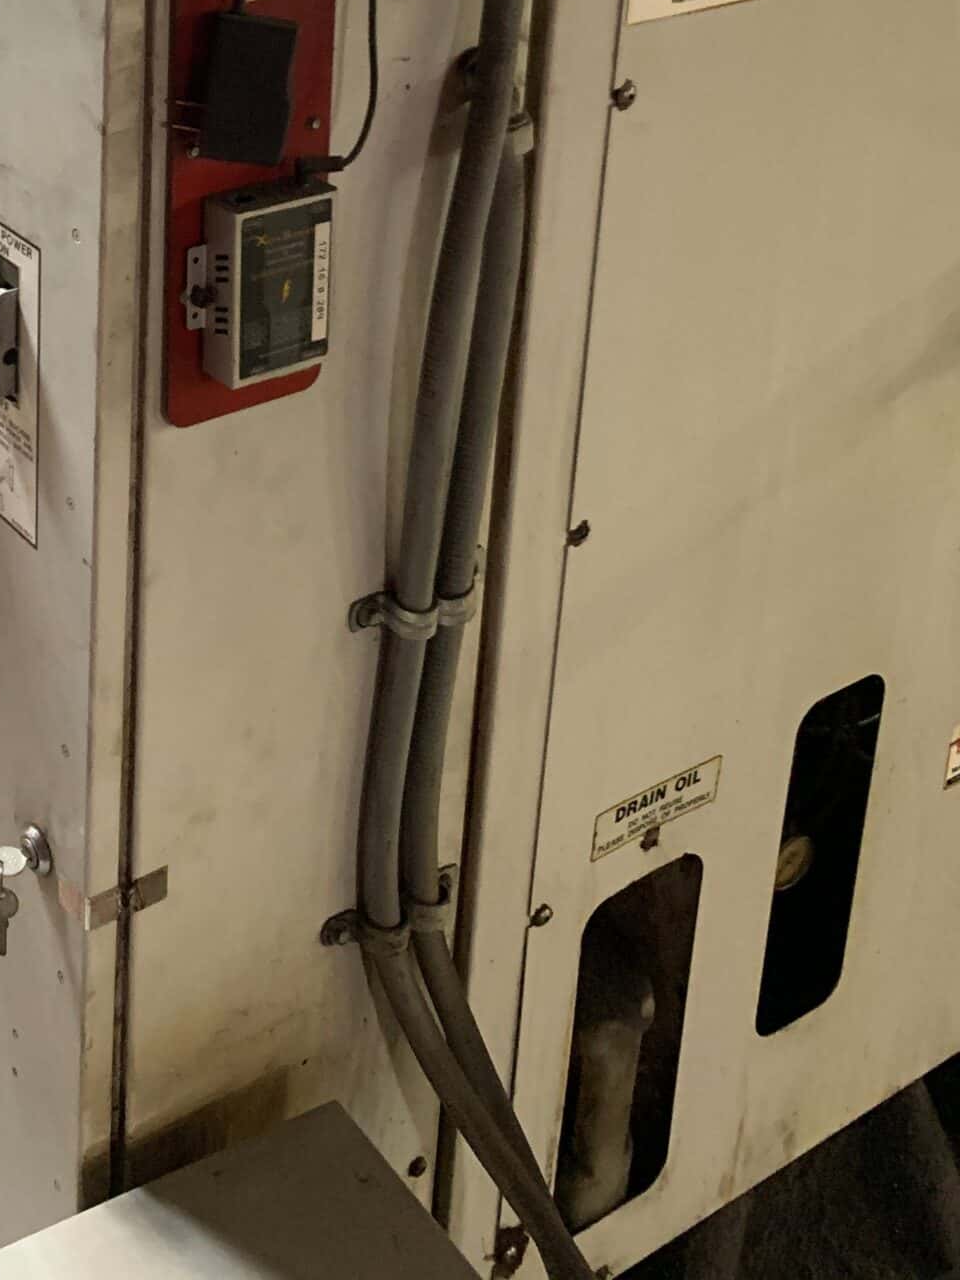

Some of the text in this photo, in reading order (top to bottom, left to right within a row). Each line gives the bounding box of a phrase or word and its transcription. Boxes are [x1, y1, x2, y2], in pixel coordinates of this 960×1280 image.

[1, 229, 33, 260] POWER
[614, 770, 701, 823] DRAIN OIL
